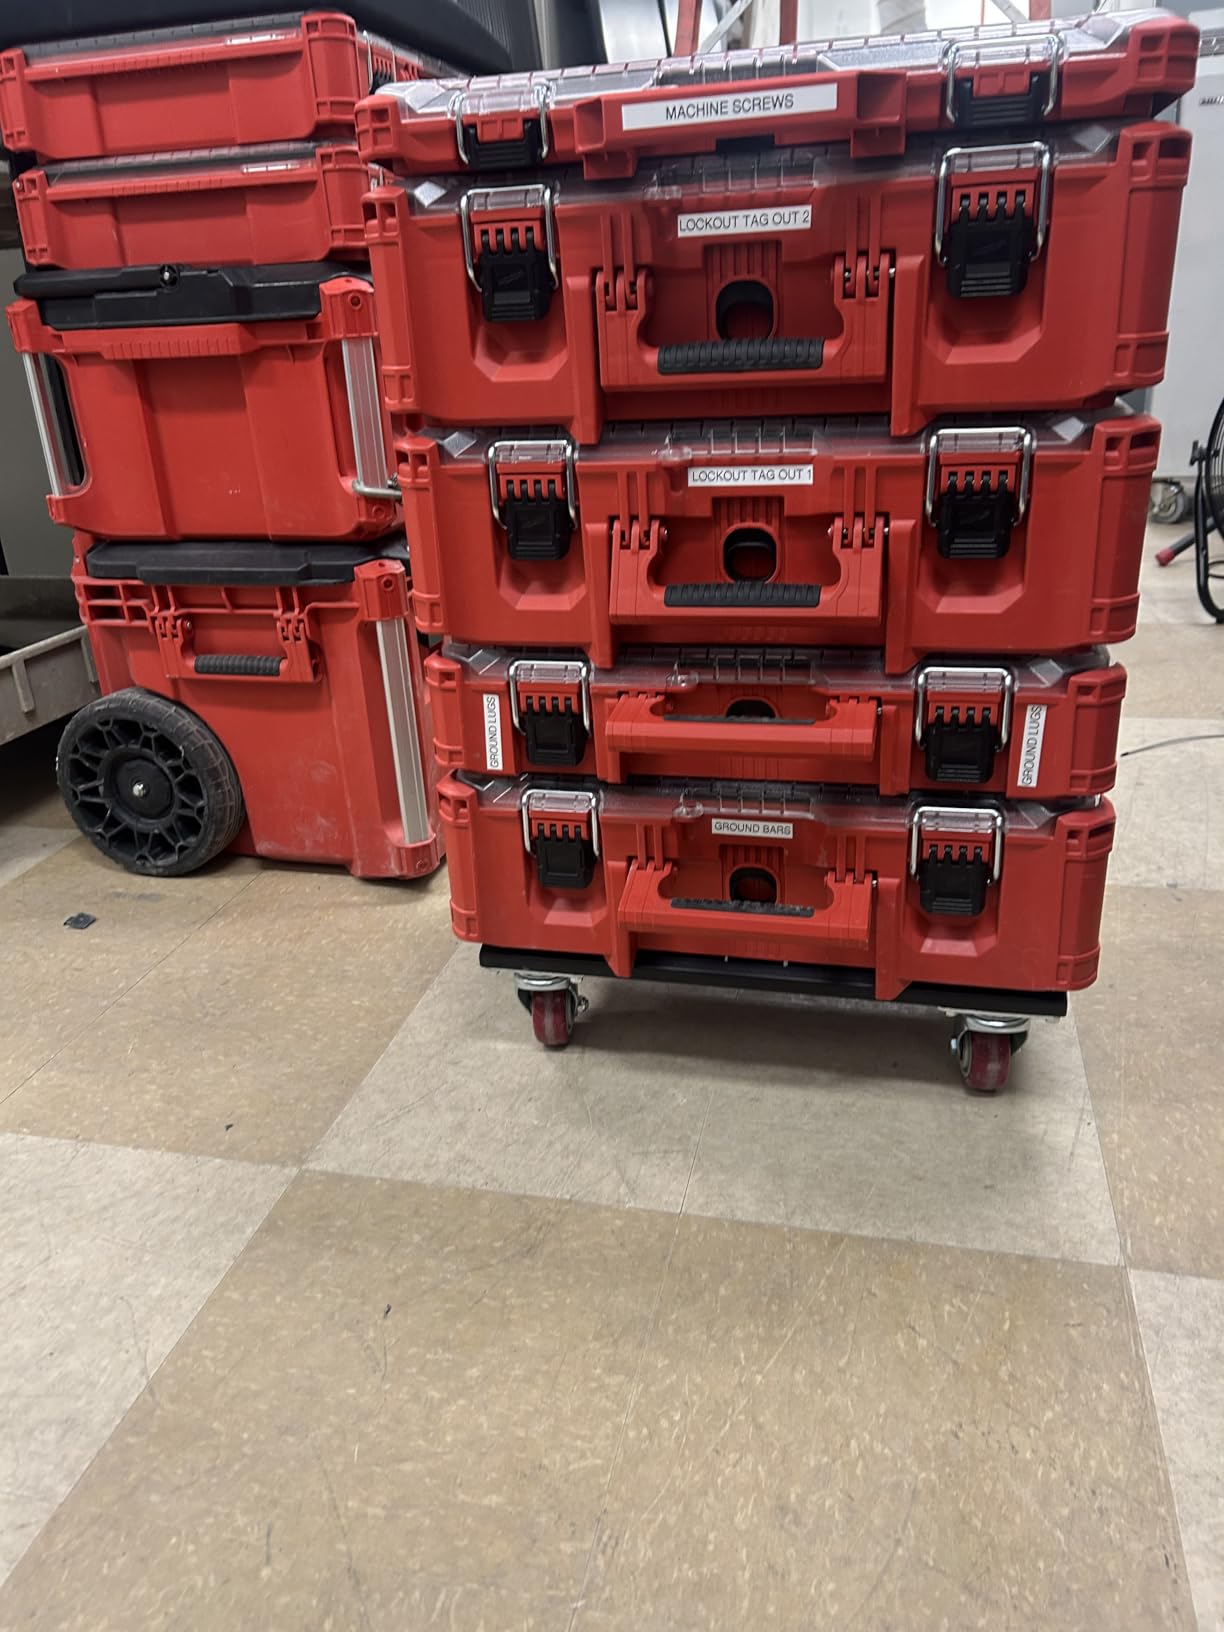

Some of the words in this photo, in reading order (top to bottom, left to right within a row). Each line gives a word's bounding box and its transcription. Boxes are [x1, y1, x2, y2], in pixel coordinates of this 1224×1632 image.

[666, 100, 728, 120] MACHINE
[732, 93, 794, 114] SCREWS
[679, 215, 739, 232] LOCKOUT
[742, 213, 769, 227] TAG
[772, 211, 800, 225] OUT
[803, 210, 810, 223] 2
[692, 470, 747, 482] LOCKOUT
[751, 469, 775, 481] TAG
[778, 468, 803, 480] OUT
[807, 469, 811, 480] 1
[486, 696, 497, 724] LUGS
[1027, 705, 1042, 735] LUGS
[488, 725, 499, 768] GROUND
[1021, 737, 1038, 785] GROUND
[714, 821, 760, 833] GROUND
[762, 824, 791, 835] BARS
